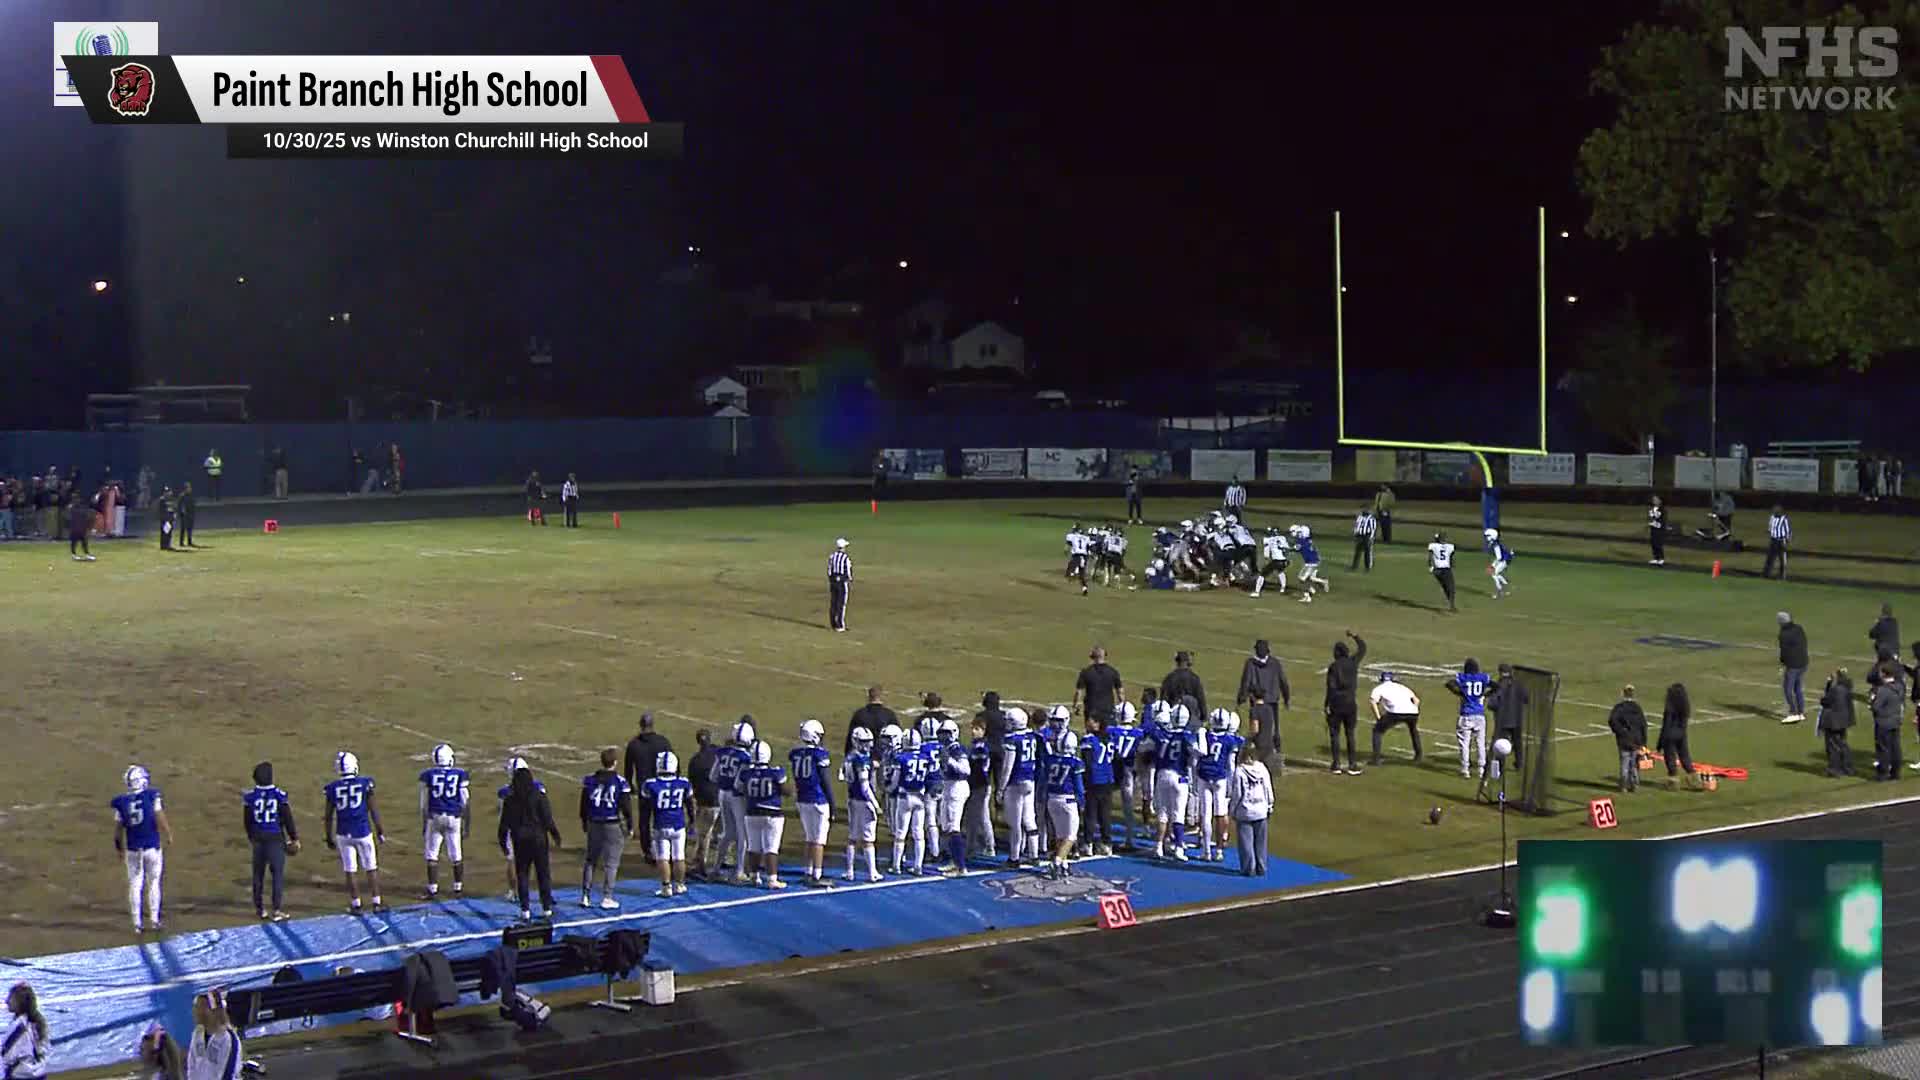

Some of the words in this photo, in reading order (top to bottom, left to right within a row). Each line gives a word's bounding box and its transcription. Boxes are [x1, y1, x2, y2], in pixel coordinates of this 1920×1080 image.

[1440, 549, 1446, 561] 5
[1466, 681, 1483, 696] 10
[1097, 742, 1115, 764] 75
[794, 754, 813, 779] 70
[905, 759, 929, 782] 35
[1047, 763, 1071, 785] 27
[335, 783, 363, 811] 55
[431, 774, 459, 799] 53
[129, 800, 144, 826] 5
[254, 799, 279, 823] 22
[1595, 802, 1616, 826] 20
[1104, 899, 1133, 924] 30
